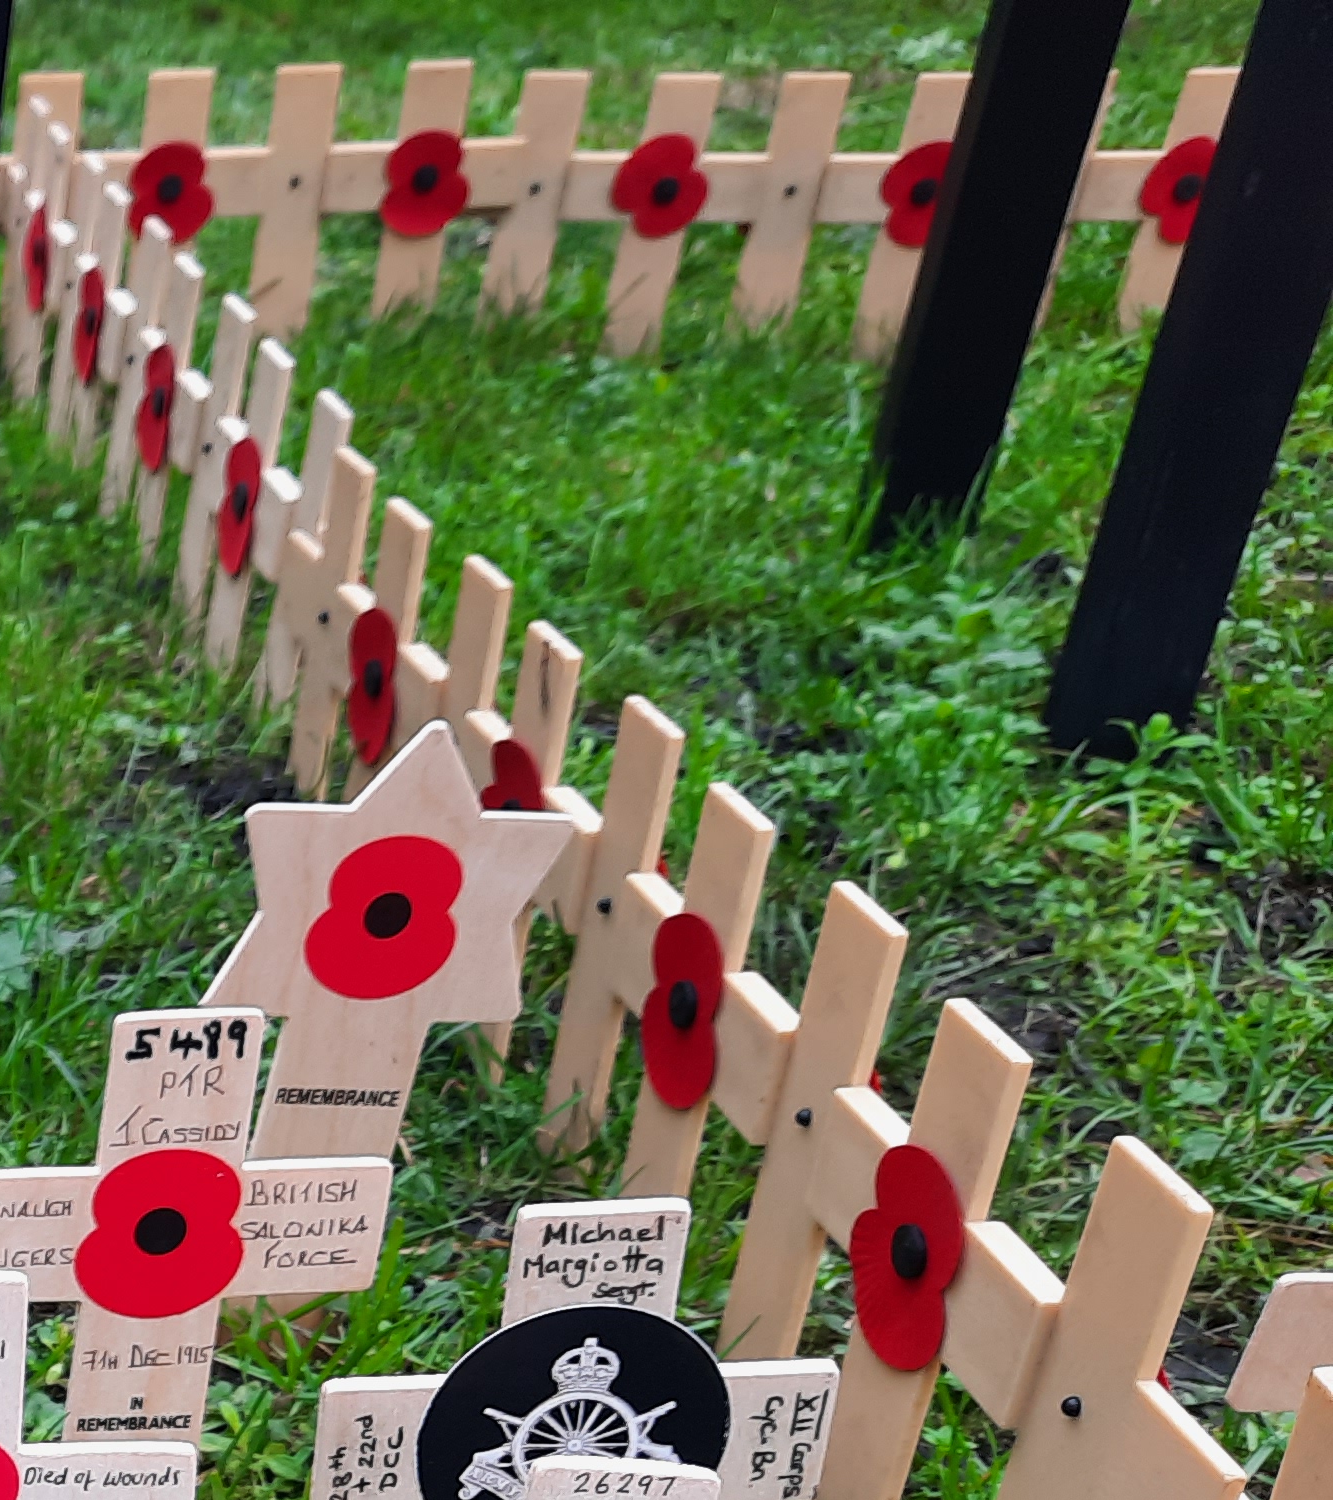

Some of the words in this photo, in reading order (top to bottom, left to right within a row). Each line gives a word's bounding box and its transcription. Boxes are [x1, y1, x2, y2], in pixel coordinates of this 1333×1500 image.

[274, 1087, 401, 1108] REMEMBRANCE
[244, 1180, 358, 1207] BRITISH
[241, 1216, 369, 1241] SALONIKA
[264, 1239, 357, 1269] FORCE
[522, 1245, 665, 1289] Margiotta
[129, 1396, 144, 1411] IN
[76, 1415, 193, 1432] REMEMBRANCE
[354, 1414, 378, 1469] 22nd
[378, 1426, 404, 1493] DCC
[777, 1443, 812, 1499] Corps
[24, 1466, 68, 1487] Died
[74, 1468, 96, 1491] of
[574, 1471, 677, 1496] 26297
